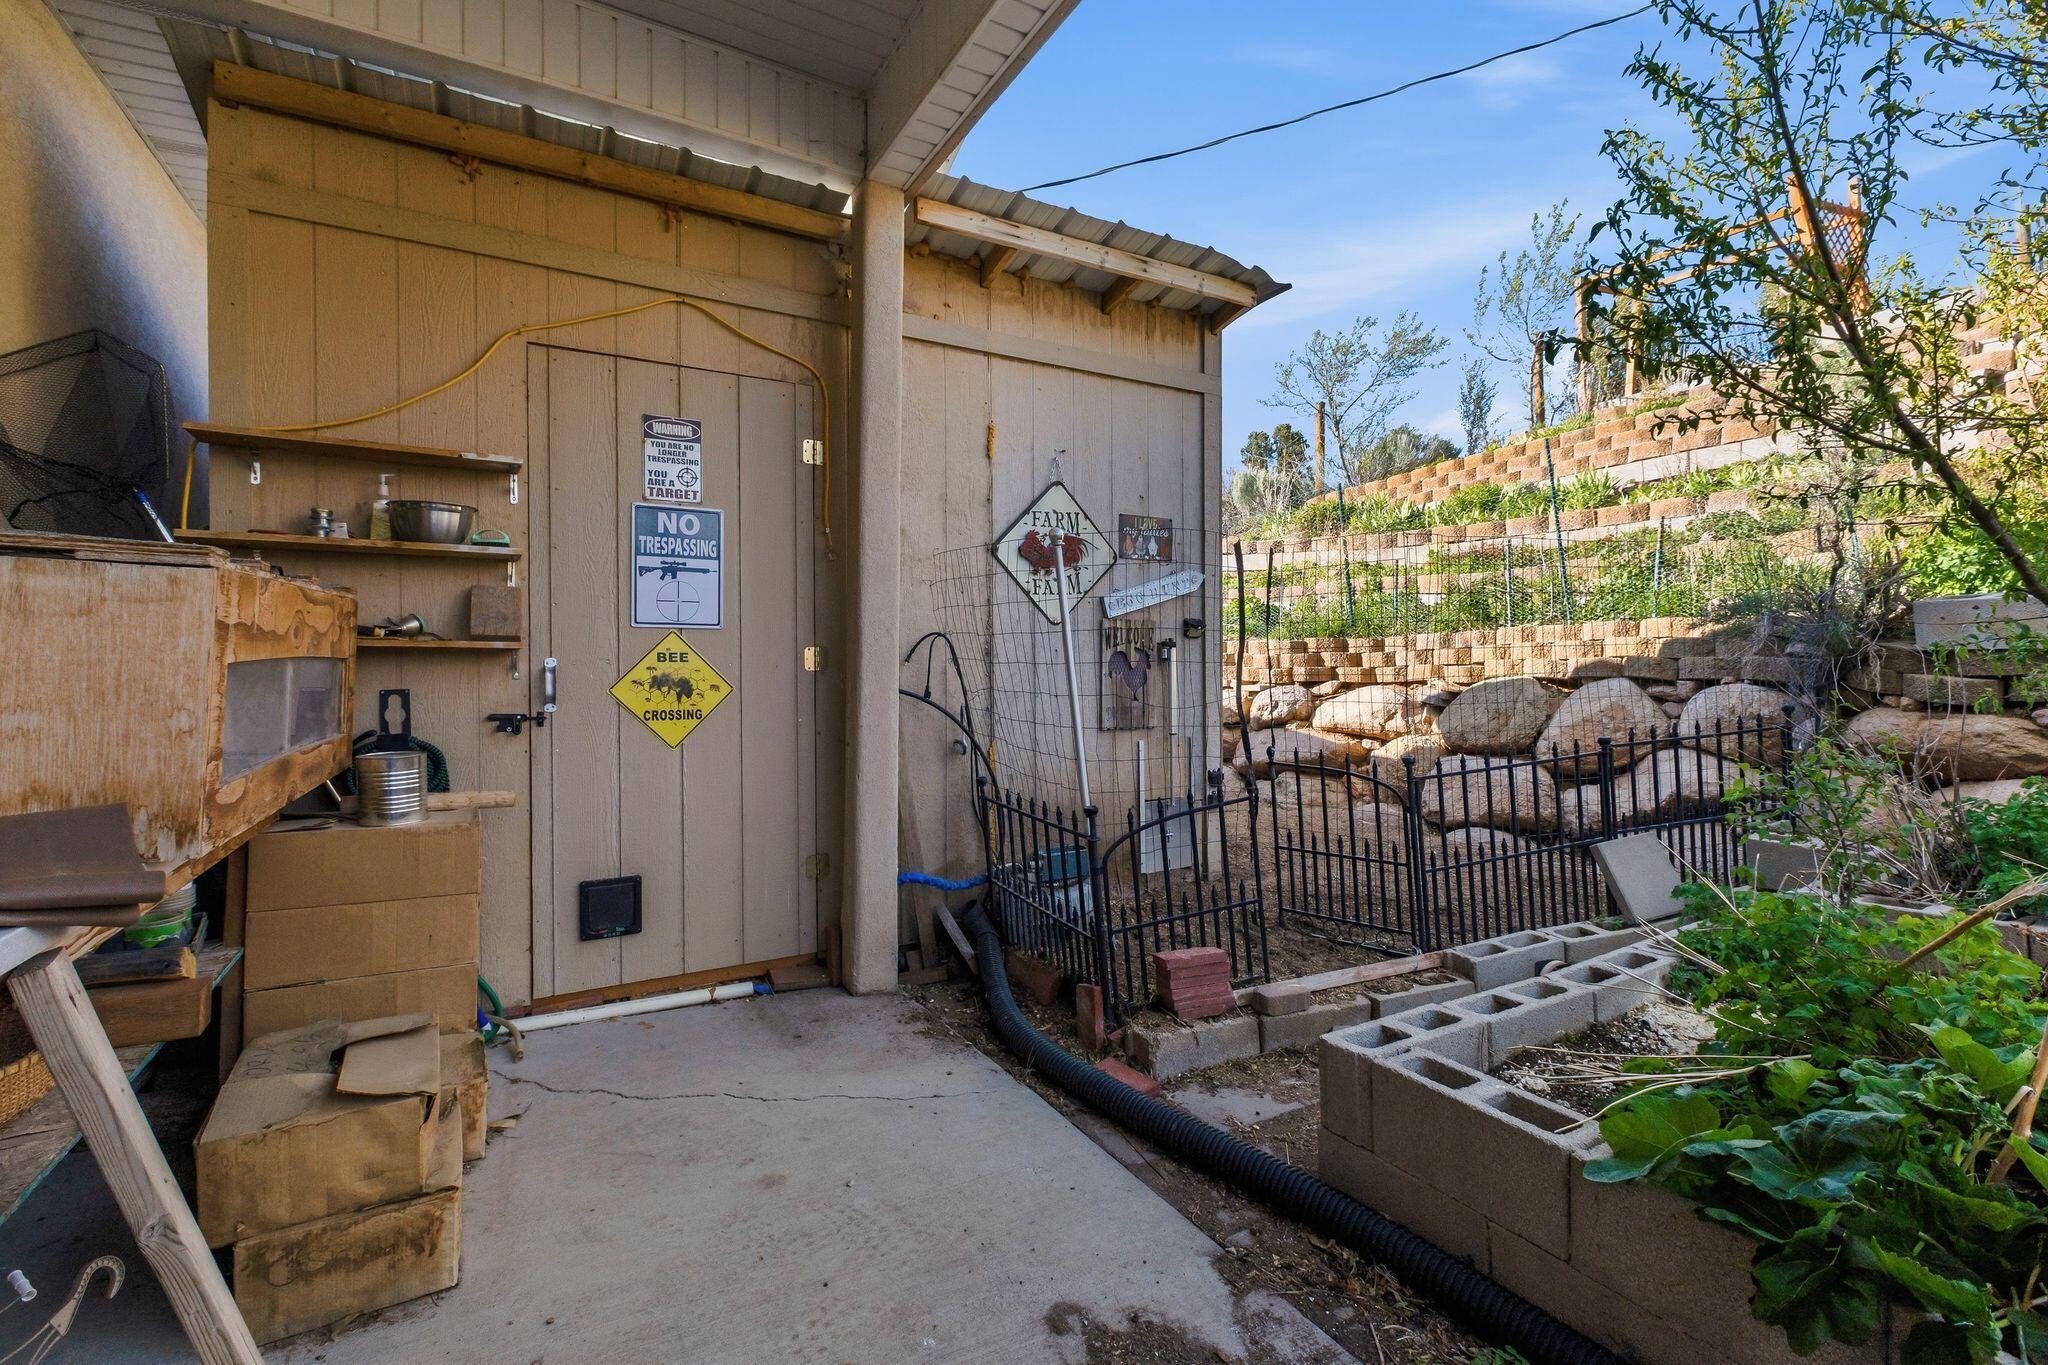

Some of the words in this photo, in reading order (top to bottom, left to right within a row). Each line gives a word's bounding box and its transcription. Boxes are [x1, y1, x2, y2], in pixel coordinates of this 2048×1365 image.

[652, 421, 693, 437] WARNING
[658, 448, 687, 458] LONGER
[683, 443, 694, 451] NO
[647, 455, 699, 466] TRESPASSING
[648, 470, 667, 478] YOU
[648, 478, 667, 486] ARE
[647, 487, 699, 500] TARGET
[657, 511, 700, 535] NO
[1031, 510, 1081, 537] FARM
[639, 535, 717, 558] TRESPASSING
[1032, 572, 1083, 596] FAM
[656, 652, 689, 663] BEE
[643, 709, 703, 722] CROSSING
